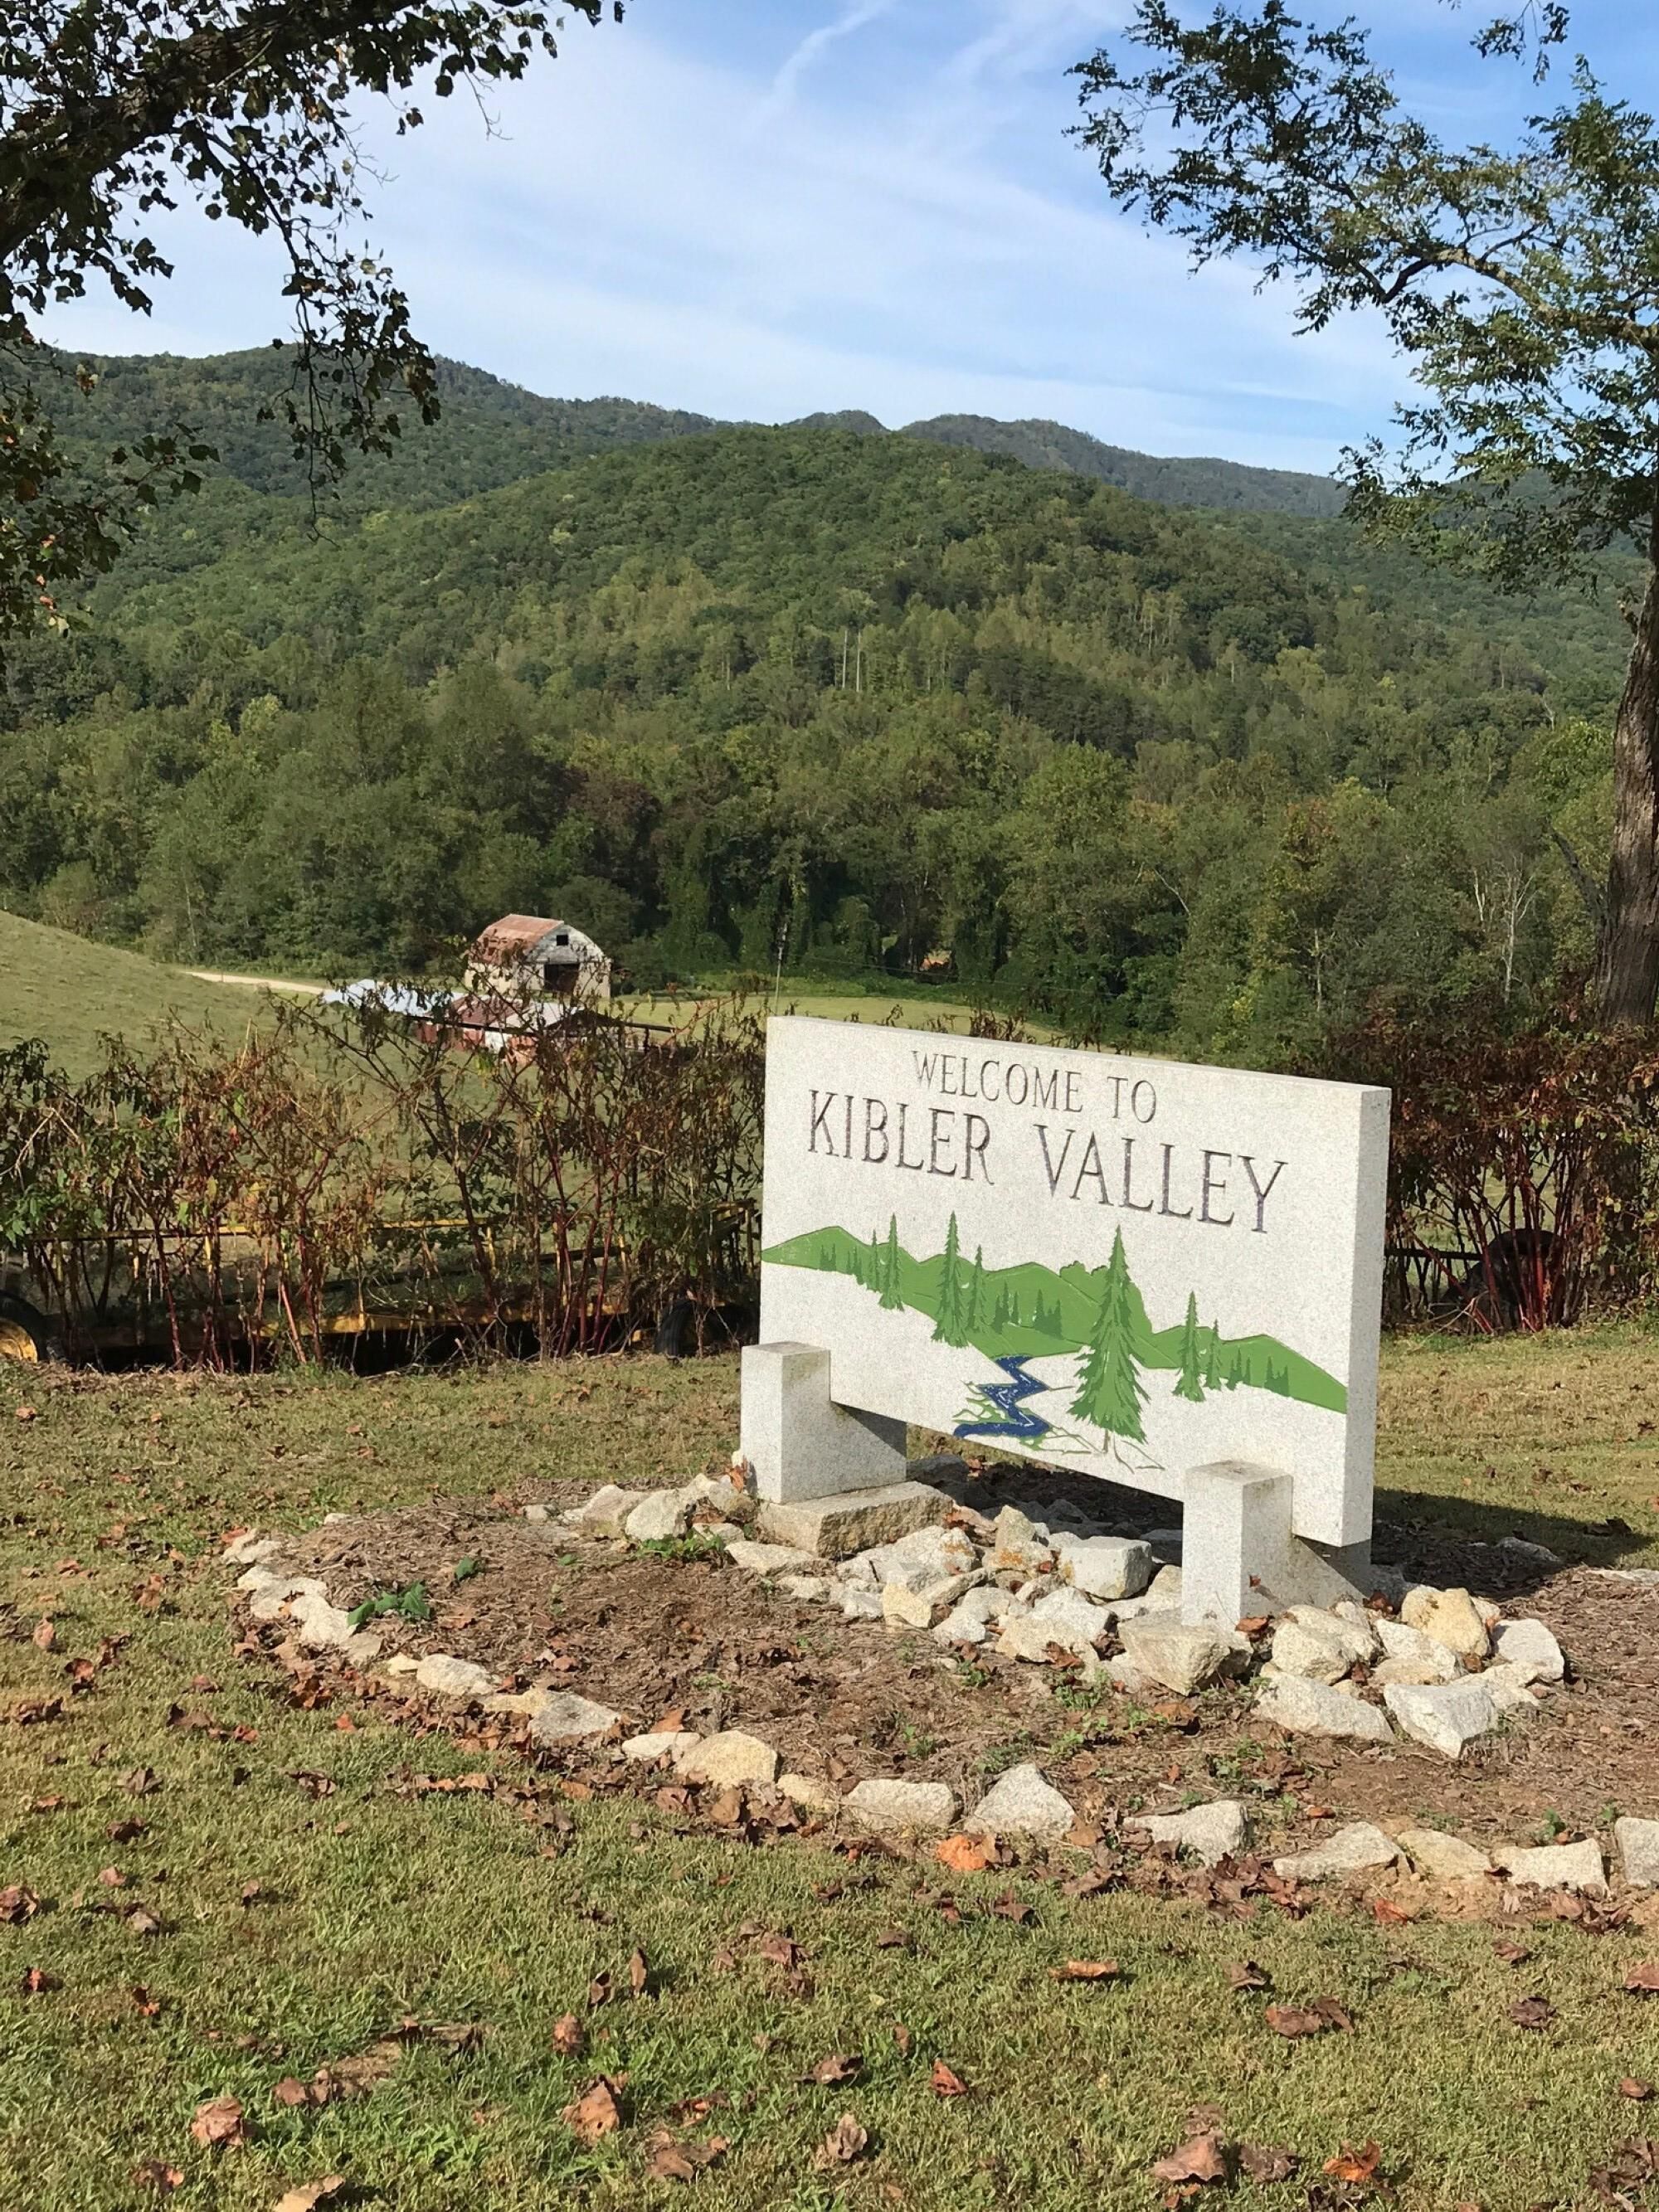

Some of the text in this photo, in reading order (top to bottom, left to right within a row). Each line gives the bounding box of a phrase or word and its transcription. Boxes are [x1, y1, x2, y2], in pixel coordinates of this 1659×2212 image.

[912, 1050, 1157, 1123] WELCOME TO
[807, 1089, 1289, 1234] KIBLER VALLEY
